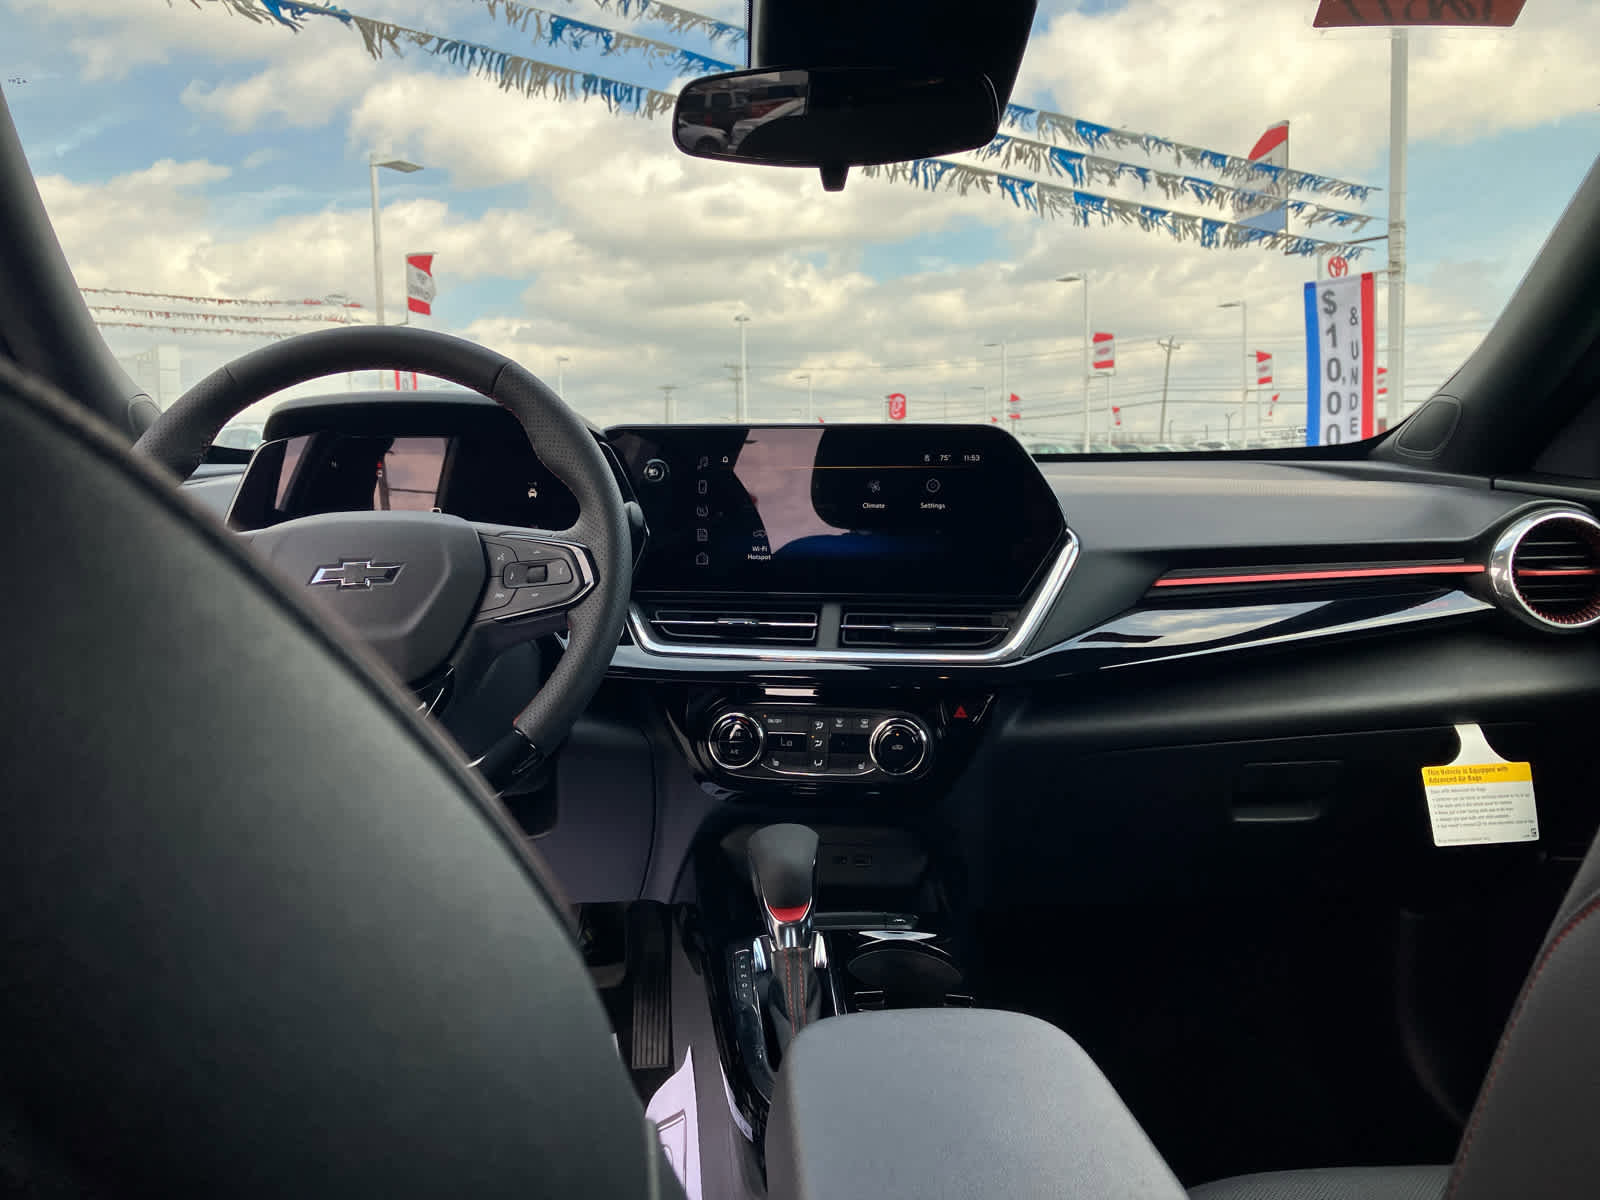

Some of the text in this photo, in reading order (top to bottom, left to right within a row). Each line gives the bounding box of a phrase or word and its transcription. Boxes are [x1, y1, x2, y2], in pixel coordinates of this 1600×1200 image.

[1349, 306, 1359, 326] &
[963, 454, 981, 462] 11:53
[919, 502, 946, 511] Settings
[747, 553, 772, 561] Hotspot
[1468, 767, 1496, 775] Equipped
[1467, 775, 1482, 783] Bags
